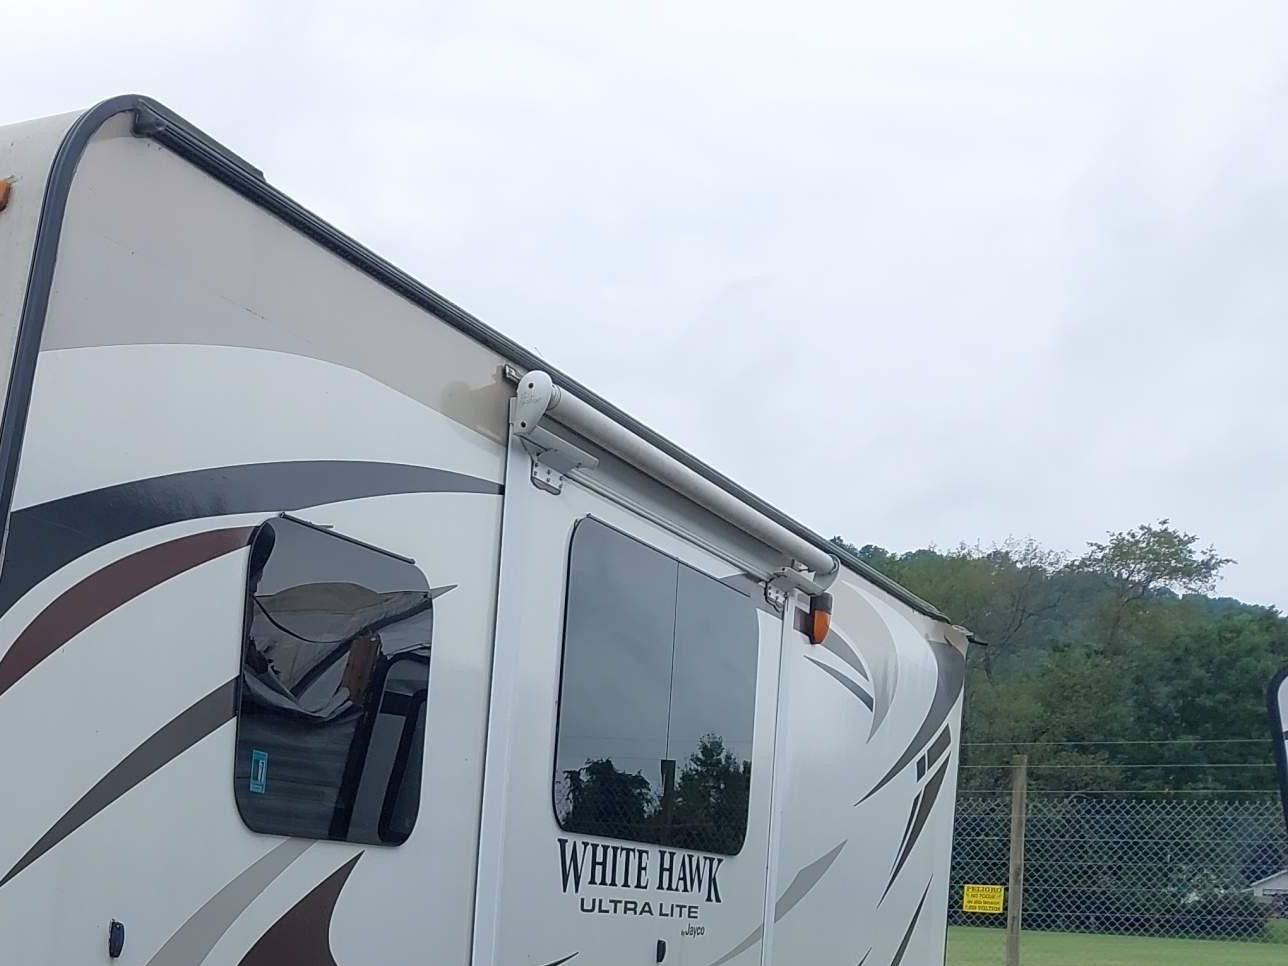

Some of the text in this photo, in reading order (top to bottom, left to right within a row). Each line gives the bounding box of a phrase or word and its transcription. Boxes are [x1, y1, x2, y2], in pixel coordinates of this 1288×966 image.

[557, 838, 724, 903] WHITE HAWK
[580, 897, 699, 919] ULTRA LITE
[685, 922, 705, 938] Jayco
